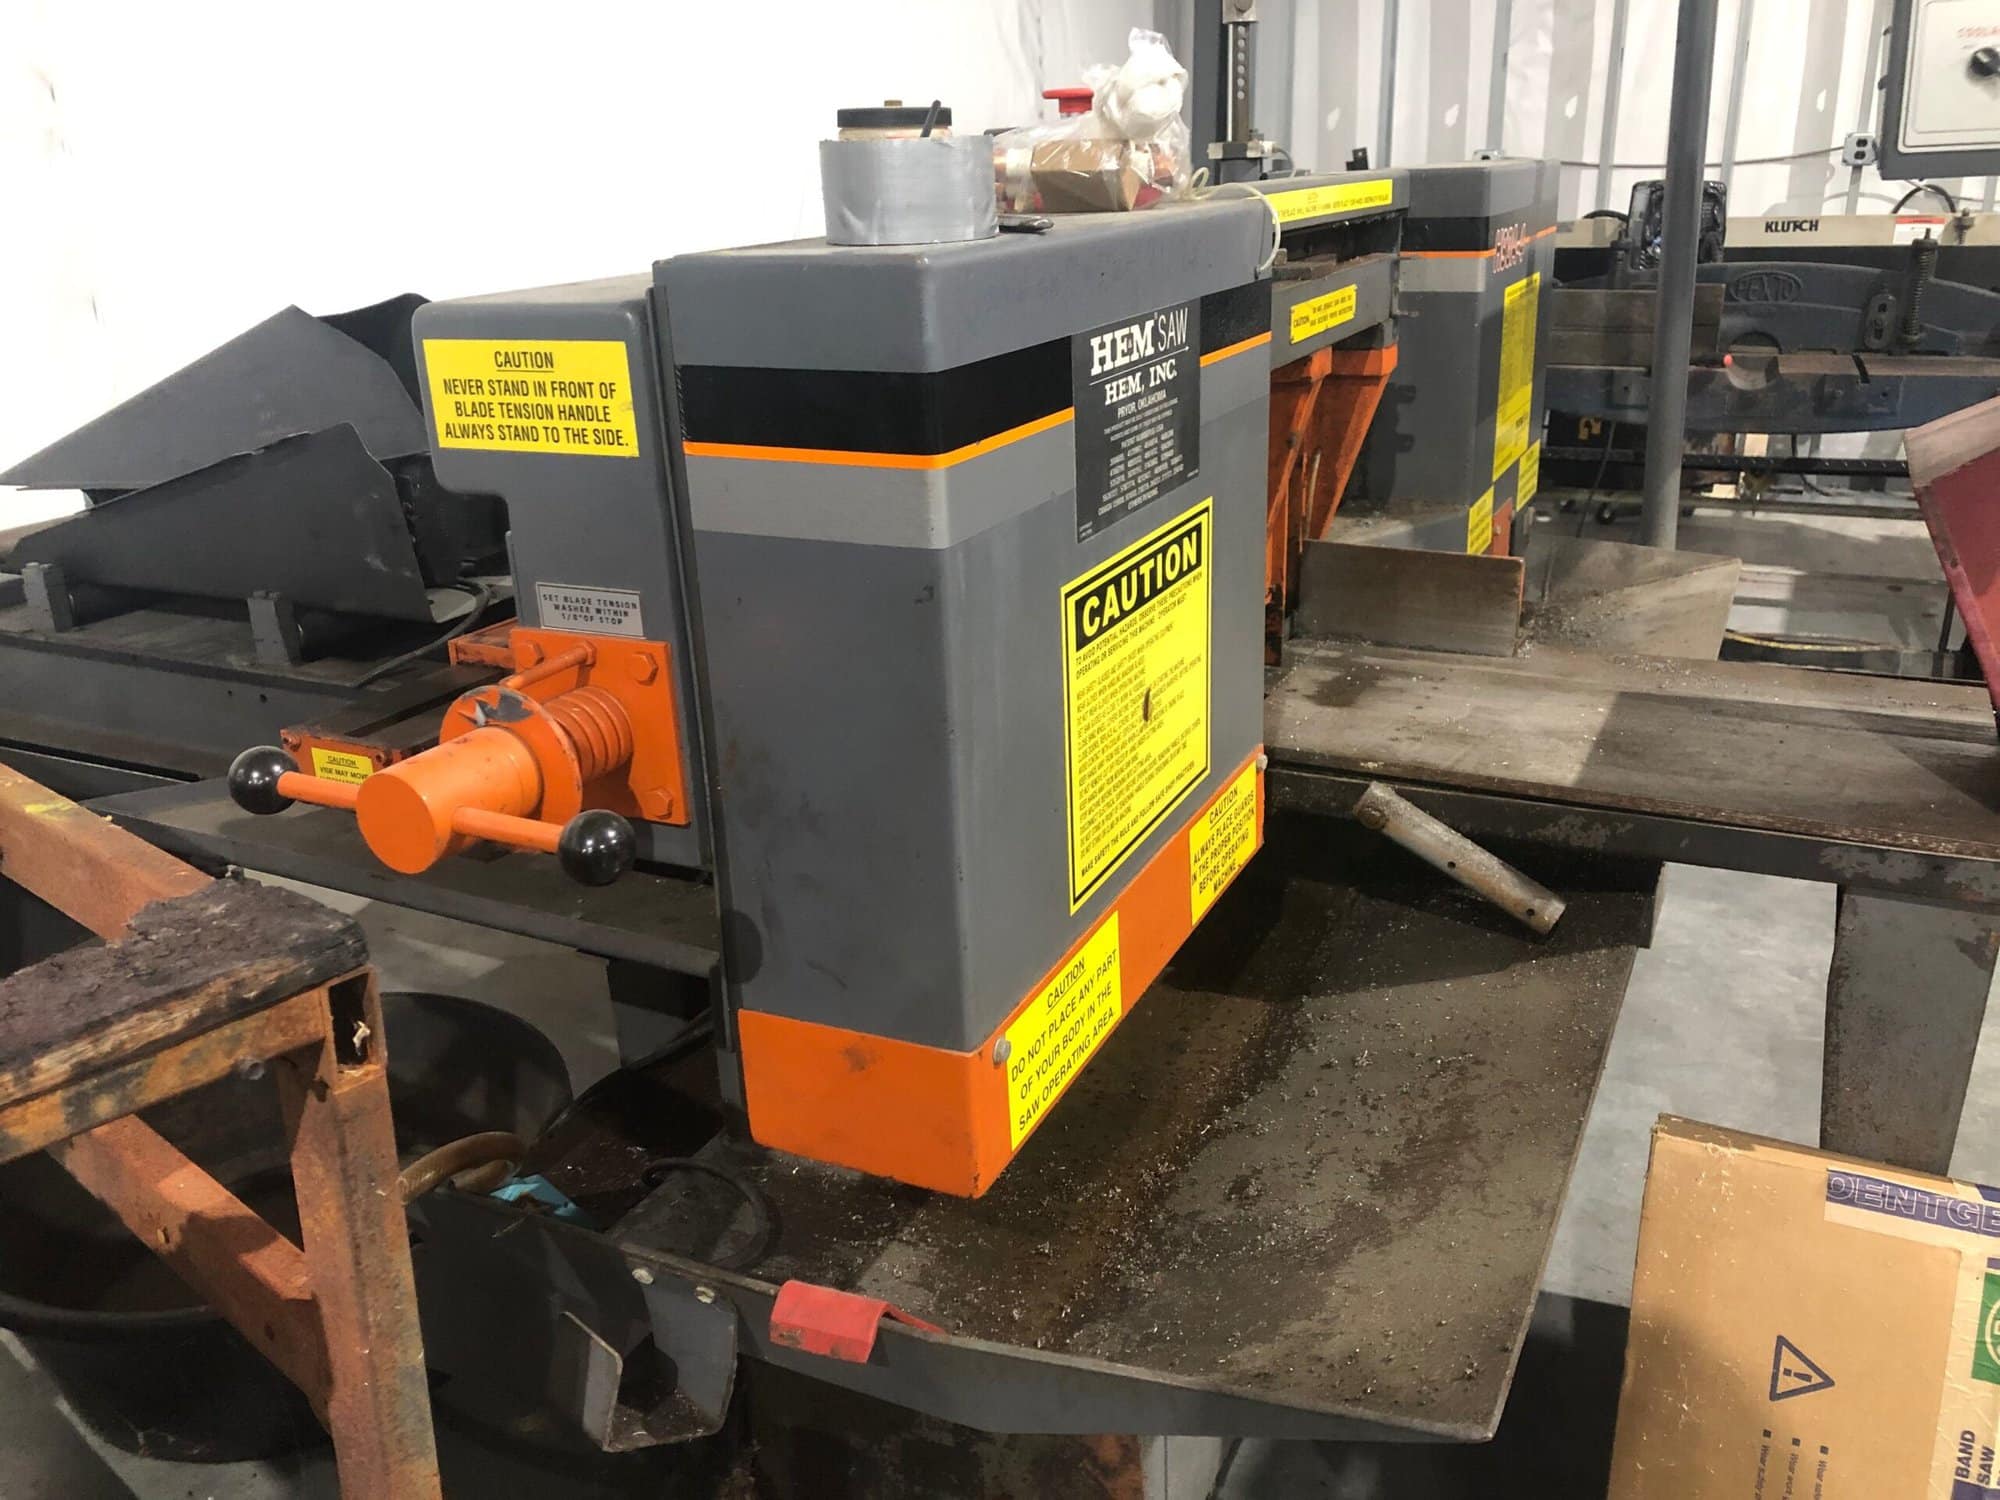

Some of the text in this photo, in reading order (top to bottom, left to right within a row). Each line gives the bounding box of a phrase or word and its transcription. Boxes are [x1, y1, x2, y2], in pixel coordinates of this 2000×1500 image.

[1764, 219, 1819, 233] KLUTCH
[494, 350, 554, 369] CAUTION
[1090, 307, 1189, 377] HEM SAW
[443, 378, 616, 400] NEVER STAND IN FRONT OF
[1104, 358, 1178, 406] HEM, INC.
[454, 400, 611, 423] BLADE TENSION HANDLE
[445, 424, 629, 447] ALWAYS STAND TO THE SIDE.
[564, 596, 592, 605] BLADE
[597, 599, 637, 608] TENSION
[1082, 530, 1197, 638] CAUTION
[595, 607, 629, 616] WITHIN
[599, 616, 623, 624] STOP
[328, 756, 356, 766] CAUTION
[1209, 785, 1239, 825] CAUTION
[1191, 807, 1255, 887] IN THE PROPER POSITION
[1193, 790, 1255, 865] ALWAYS PLACE GUARDS
[1199, 828, 1249, 895] BEFORE OPERATING
[1213, 858, 1237, 893] MACHINE
[1046, 958, 1085, 1009] CAUTION
[1011, 948, 1118, 1083] DO NOT PLACE ANY PART
[1020, 980, 1112, 1101] OF YOUR BODY IN THE
[1018, 1006, 1115, 1132] SAW OPERATING AREA
[1954, 1429, 1976, 1479] BAND
[1976, 1445, 1995, 1486] SAW
